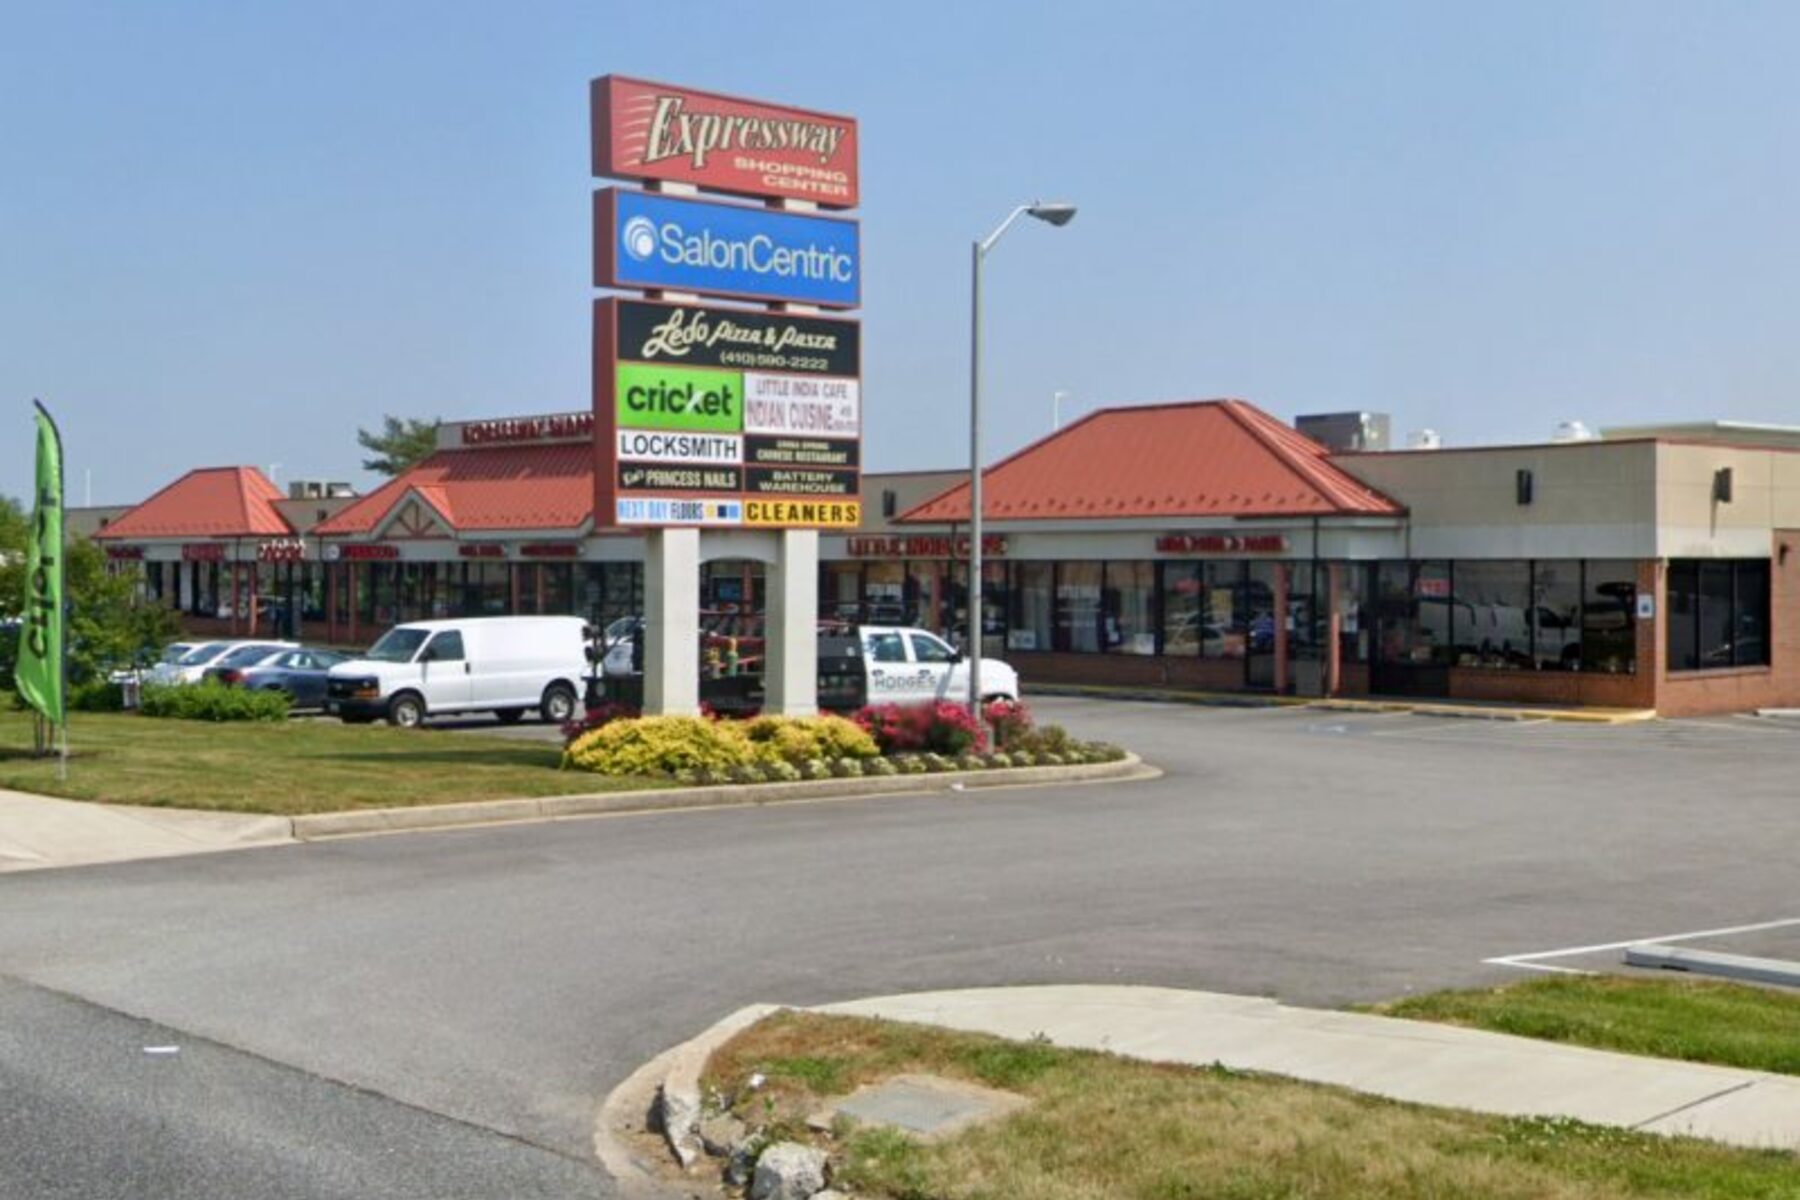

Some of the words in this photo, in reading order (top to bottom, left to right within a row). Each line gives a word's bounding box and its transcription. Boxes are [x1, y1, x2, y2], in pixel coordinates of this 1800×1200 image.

[642, 96, 846, 169] Expressway
[734, 156, 848, 185] SHOPPING
[762, 174, 849, 196] CENTER
[660, 223, 852, 282] SalonCentric
[642, 308, 710, 358] Ledo
[706, 320, 763, 348] Pizza
[774, 326, 838, 352] Pasta
[627, 380, 733, 416] cricket
[620, 434, 737, 458] LOCKSMITH
[645, 469, 701, 487] PRINCESS
[704, 471, 737, 488] NAILS
[759, 482, 846, 493] WAREHOUSE
[772, 470, 833, 483] BATTERY
[746, 502, 857, 522] CLEANERS
